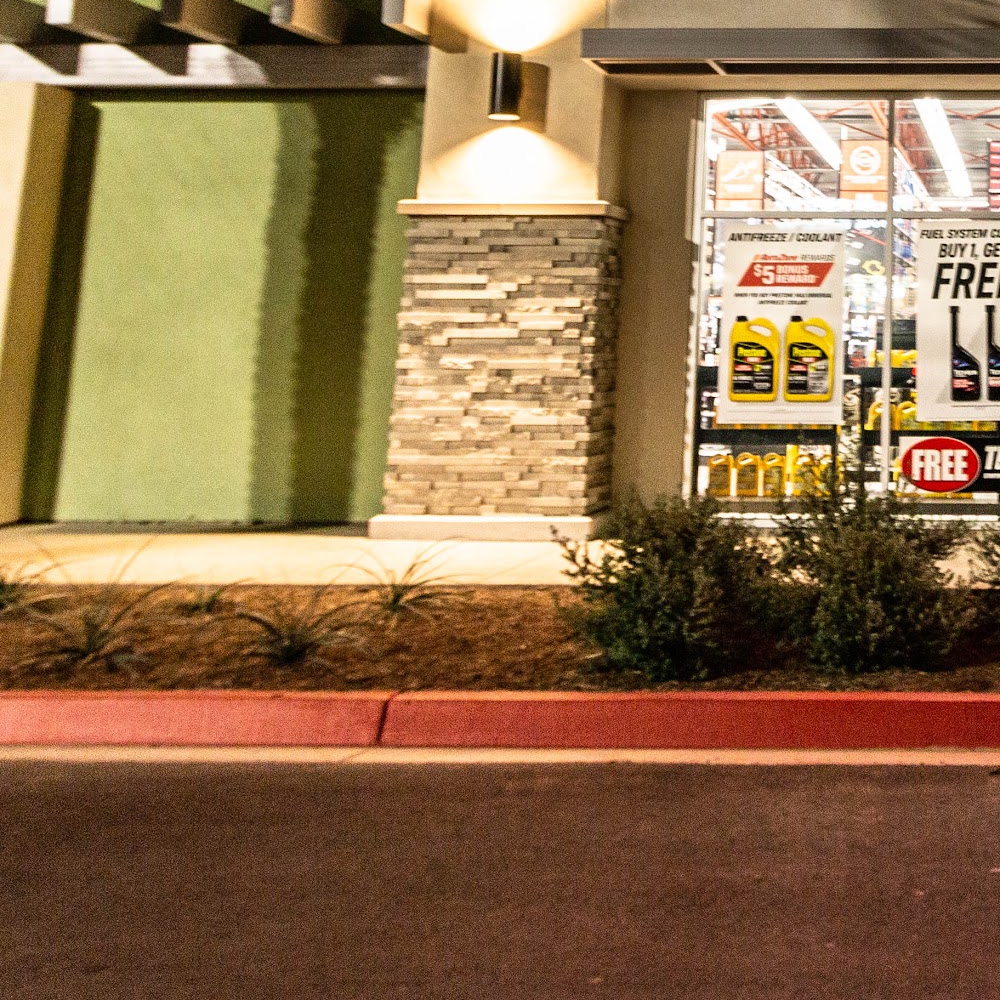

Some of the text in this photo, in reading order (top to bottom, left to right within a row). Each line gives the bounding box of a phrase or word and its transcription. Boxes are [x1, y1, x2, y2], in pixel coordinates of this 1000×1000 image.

[728, 232, 787, 242] ANTIFREEZE
[796, 232, 843, 242] COOLANT
[920, 229, 944, 239] FUEL
[947, 229, 988, 239] SYSTEM
[938, 243, 968, 258] BUY
[970, 243, 979, 260] 1,
[752, 263, 775, 285] $5
[776, 264, 809, 274] BONUS
[776, 274, 816, 284] REWARD
[911, 448, 969, 482] FREE
